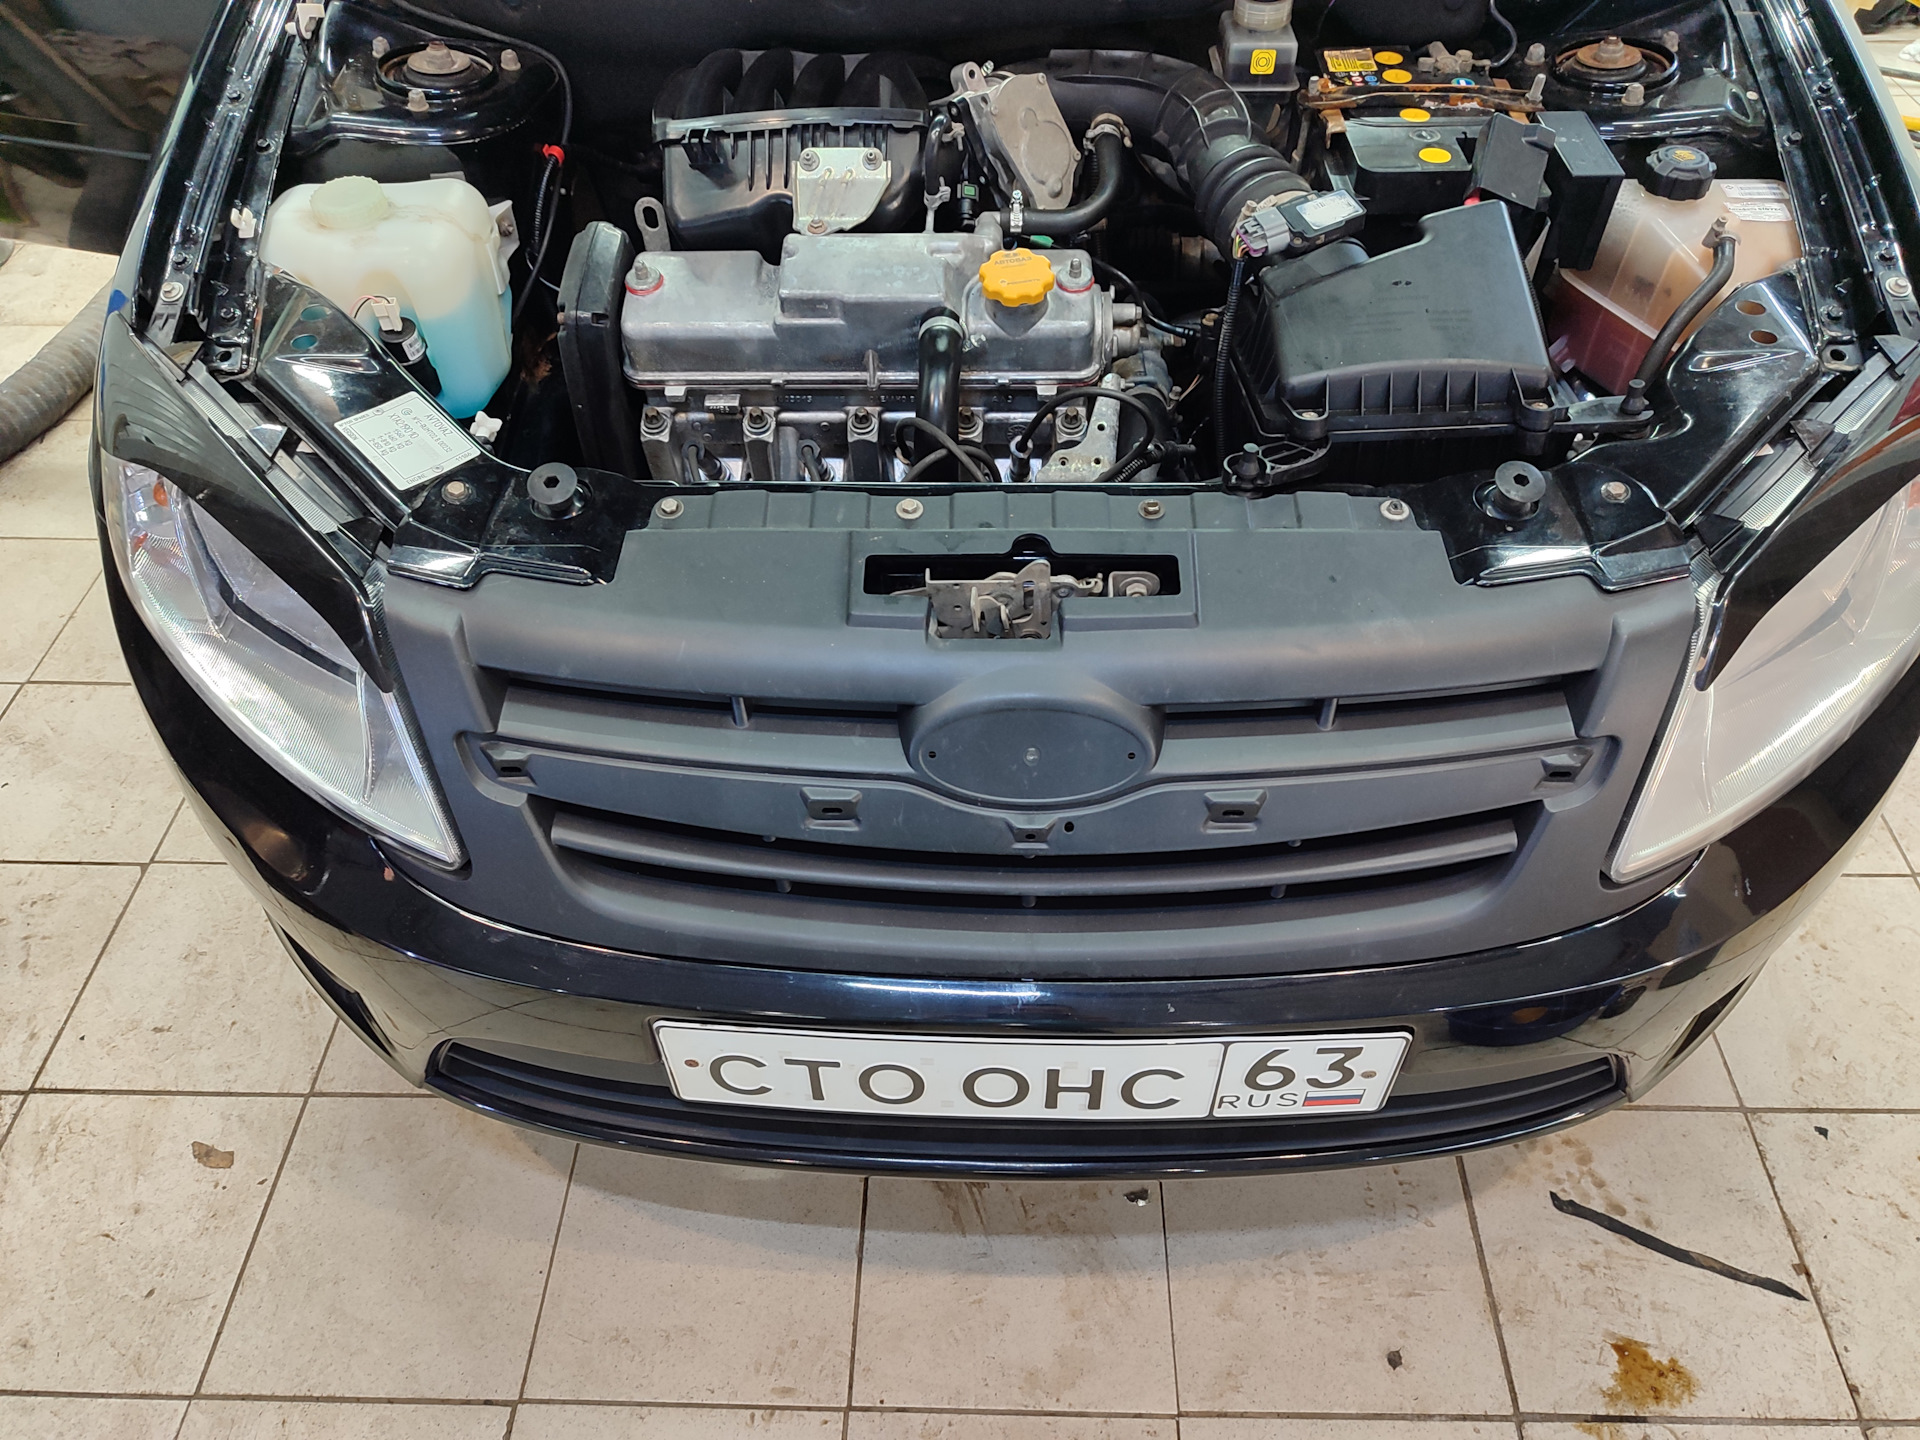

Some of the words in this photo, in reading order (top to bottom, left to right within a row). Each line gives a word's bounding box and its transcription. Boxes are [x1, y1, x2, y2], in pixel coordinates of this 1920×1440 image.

[424, 413, 453, 437] AVTOVAZ
[405, 474, 427, 485] ENGINE
[1244, 1046, 1365, 1091] 63
[1217, 1092, 1299, 1109] RUS
